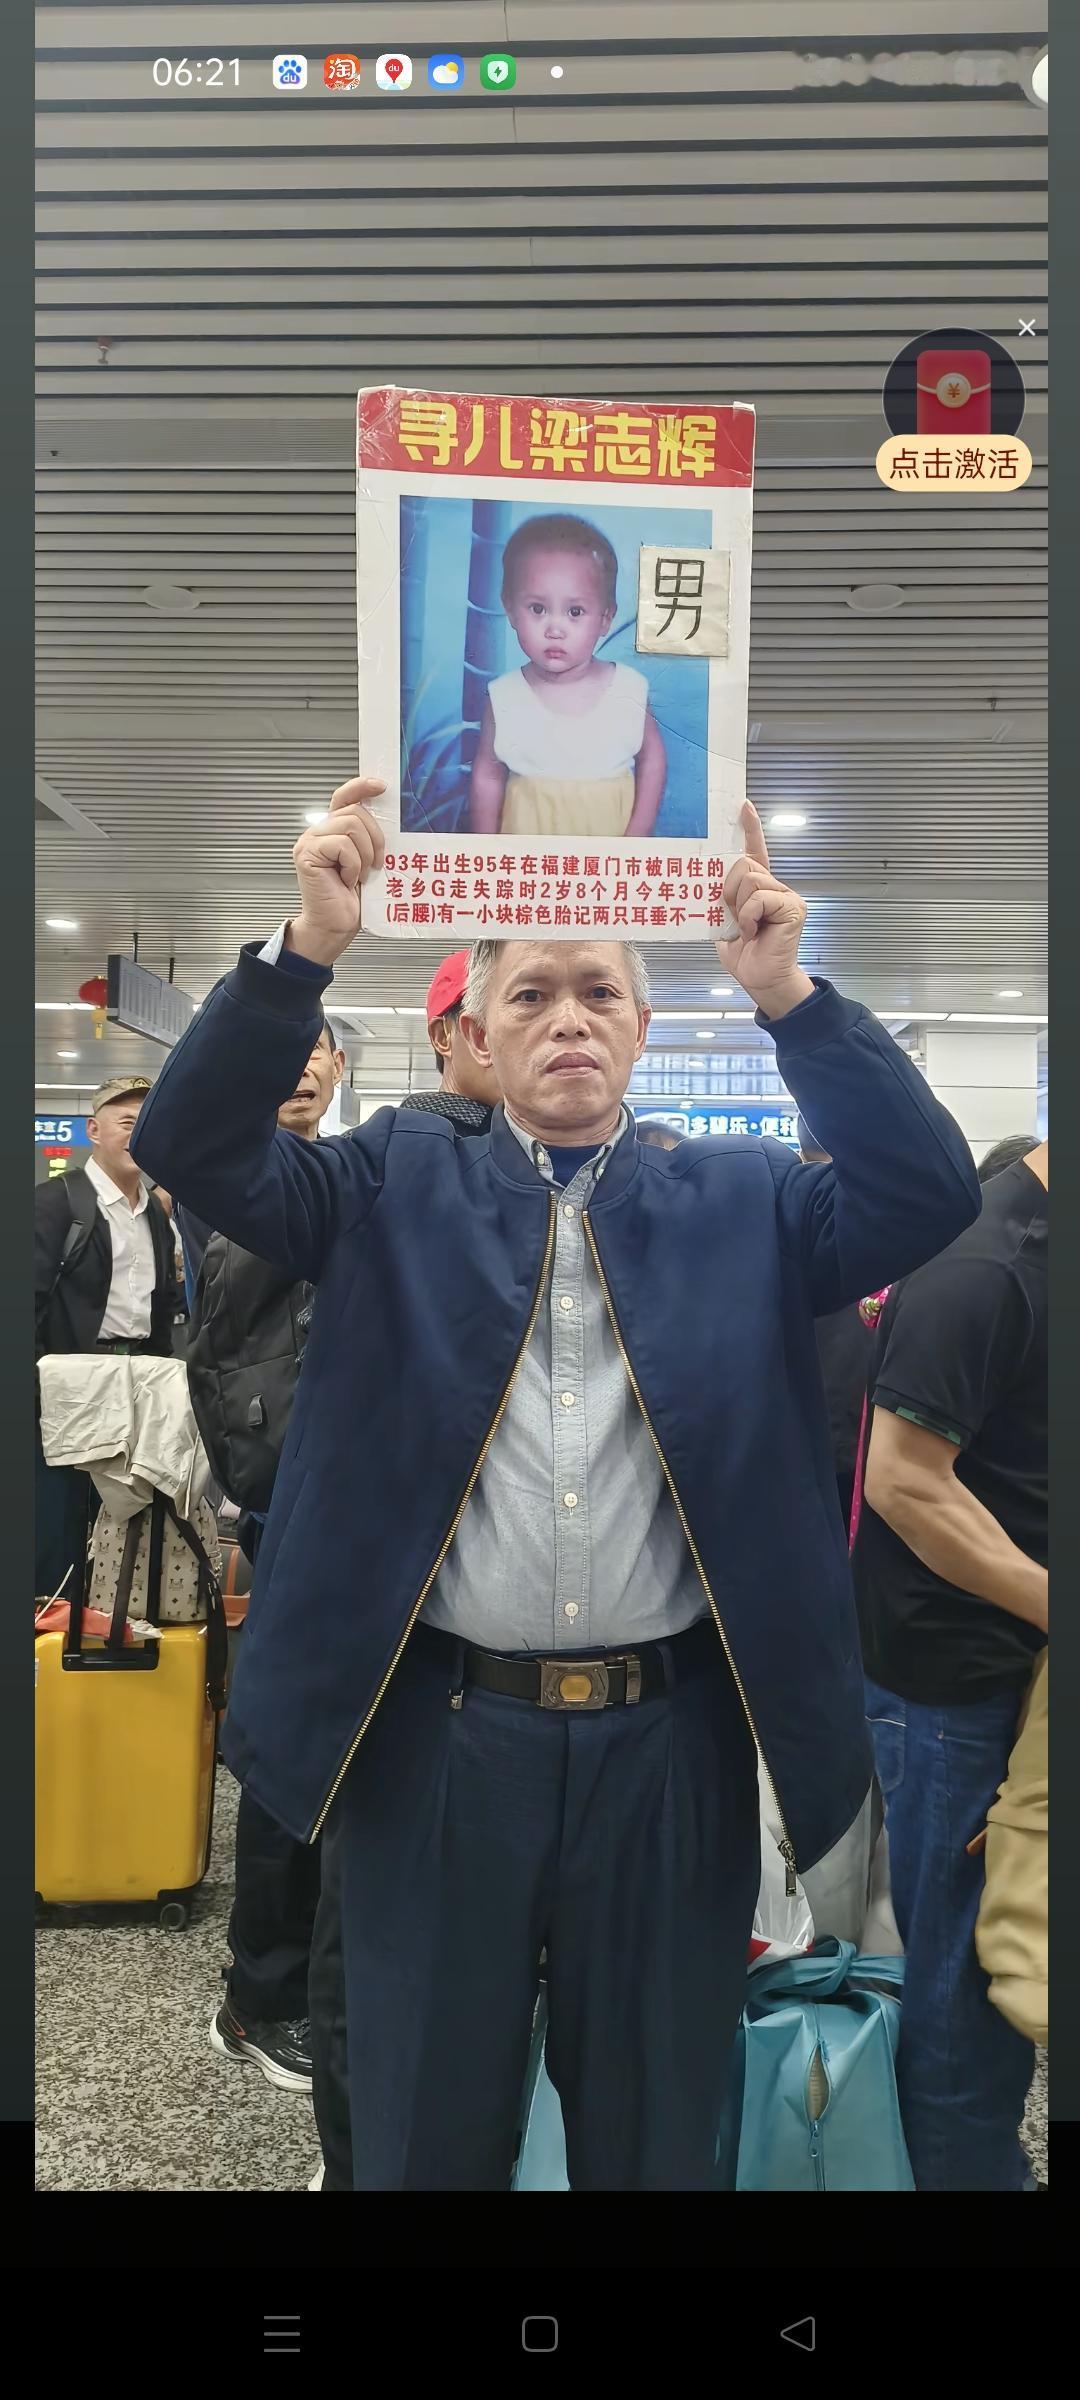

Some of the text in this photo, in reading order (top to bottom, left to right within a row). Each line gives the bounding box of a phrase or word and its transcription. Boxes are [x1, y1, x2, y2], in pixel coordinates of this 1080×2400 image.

[398, 400, 717, 478] 寻儿梁志辉
[654, 557, 705, 641] 男
[385, 853, 724, 878] 93年出生95年在福建厦门市被同住的
[386, 877, 723, 902] 老乡G走失踪时2岁8个月今年30岁
[386, 902, 725, 927] (后腰)有一小块棕色胎记两只耳垂不一样
